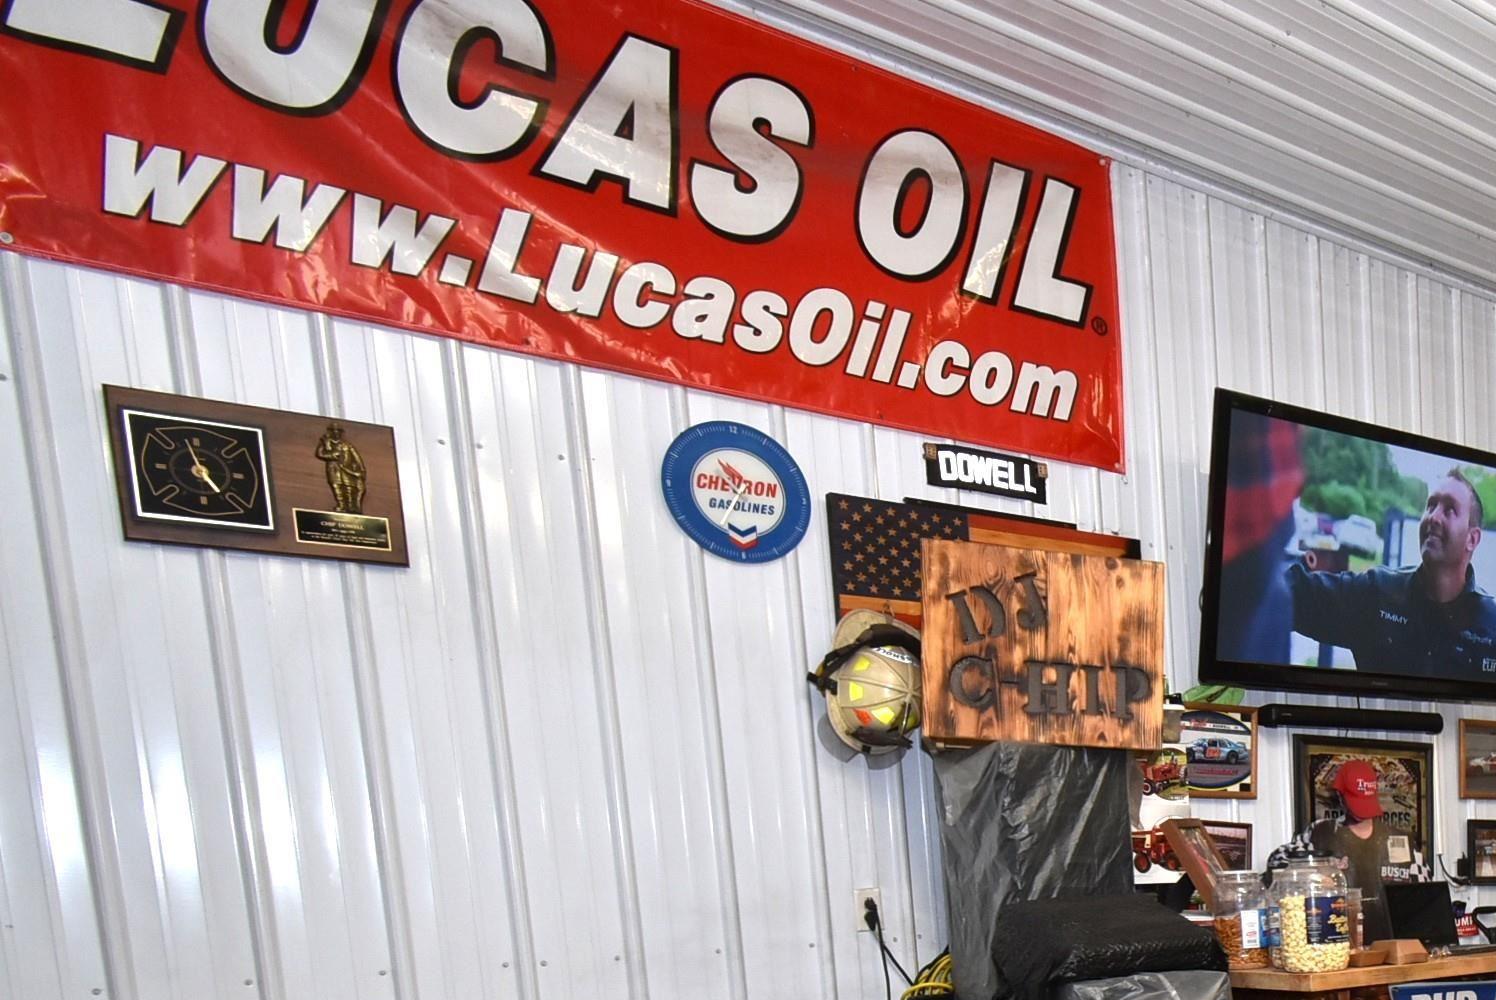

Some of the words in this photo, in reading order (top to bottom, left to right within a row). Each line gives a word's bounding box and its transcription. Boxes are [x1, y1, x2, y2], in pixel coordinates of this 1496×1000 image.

[854, 126, 1092, 330] OIL
[101, 131, 1080, 423] www.LucasOil.com
[937, 450, 1037, 494] DOWELL
[709, 497, 775, 516] GASOLINES
[1379, 609, 1409, 625] TIMMY
[1381, 865, 1410, 881] BUSCH
